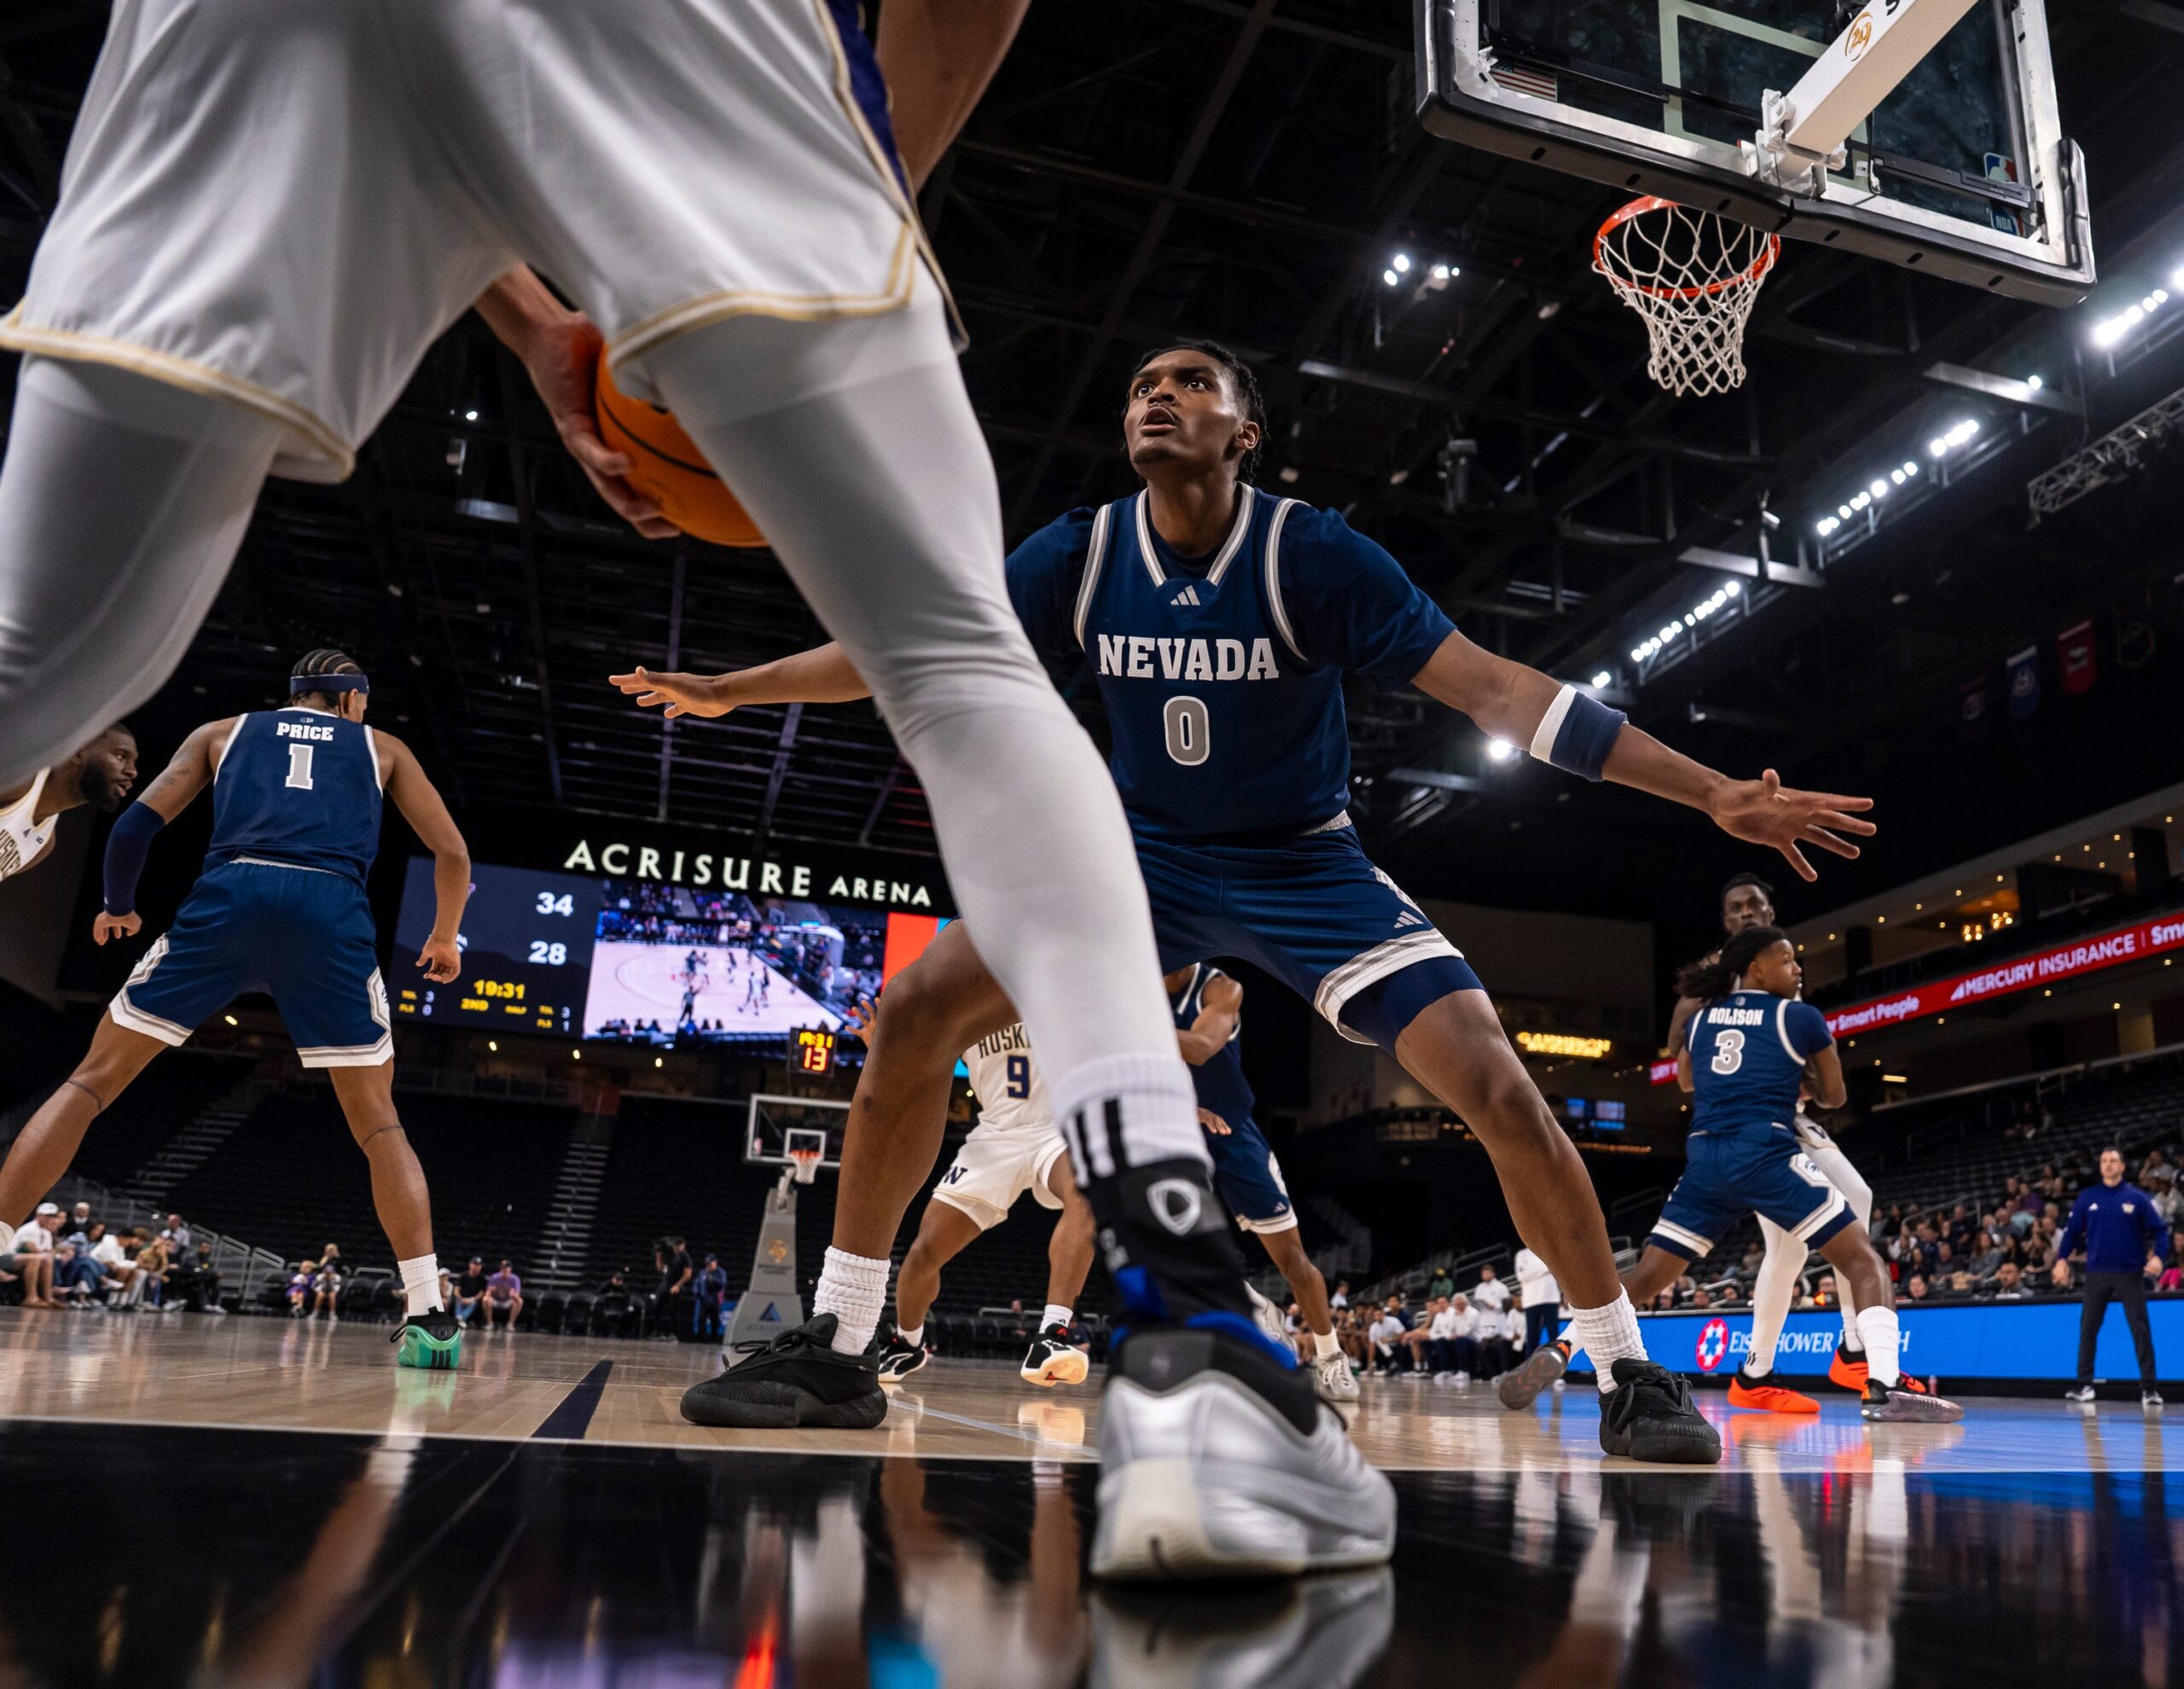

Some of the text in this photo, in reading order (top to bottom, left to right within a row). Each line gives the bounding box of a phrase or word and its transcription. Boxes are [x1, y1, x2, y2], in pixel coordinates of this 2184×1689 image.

[1995, 214, 2013, 232] NBA
[1097, 634, 1280, 682] NEVADA
[276, 722, 334, 741] PRICE
[1163, 695, 1211, 766] 0
[285, 743, 314, 790] 1
[563, 839, 932, 907] ACRISURE ARENA
[536, 891, 573, 917] 34
[528, 940, 566, 965] 28
[1965, 961, 2036, 997] MERCURY
[2038, 933, 2136, 978] INSURANCE
[426, 990, 434, 1003] 3
[473, 980, 526, 1000] 19:31
[461, 998, 489, 1012] 2ND
[561, 1007, 571, 1019] 3
[1707, 1007, 1763, 1025] ROLISON
[1838, 1007, 1876, 1031] Smart
[1877, 995, 1920, 1021] People
[564, 1021, 570, 1032] 1
[804, 1047, 827, 1071] 13
[1711, 1029, 1745, 1075] 3
[1007, 1054, 1031, 1100] 9
[1728, 1331, 1834, 1354] EISHOWER
